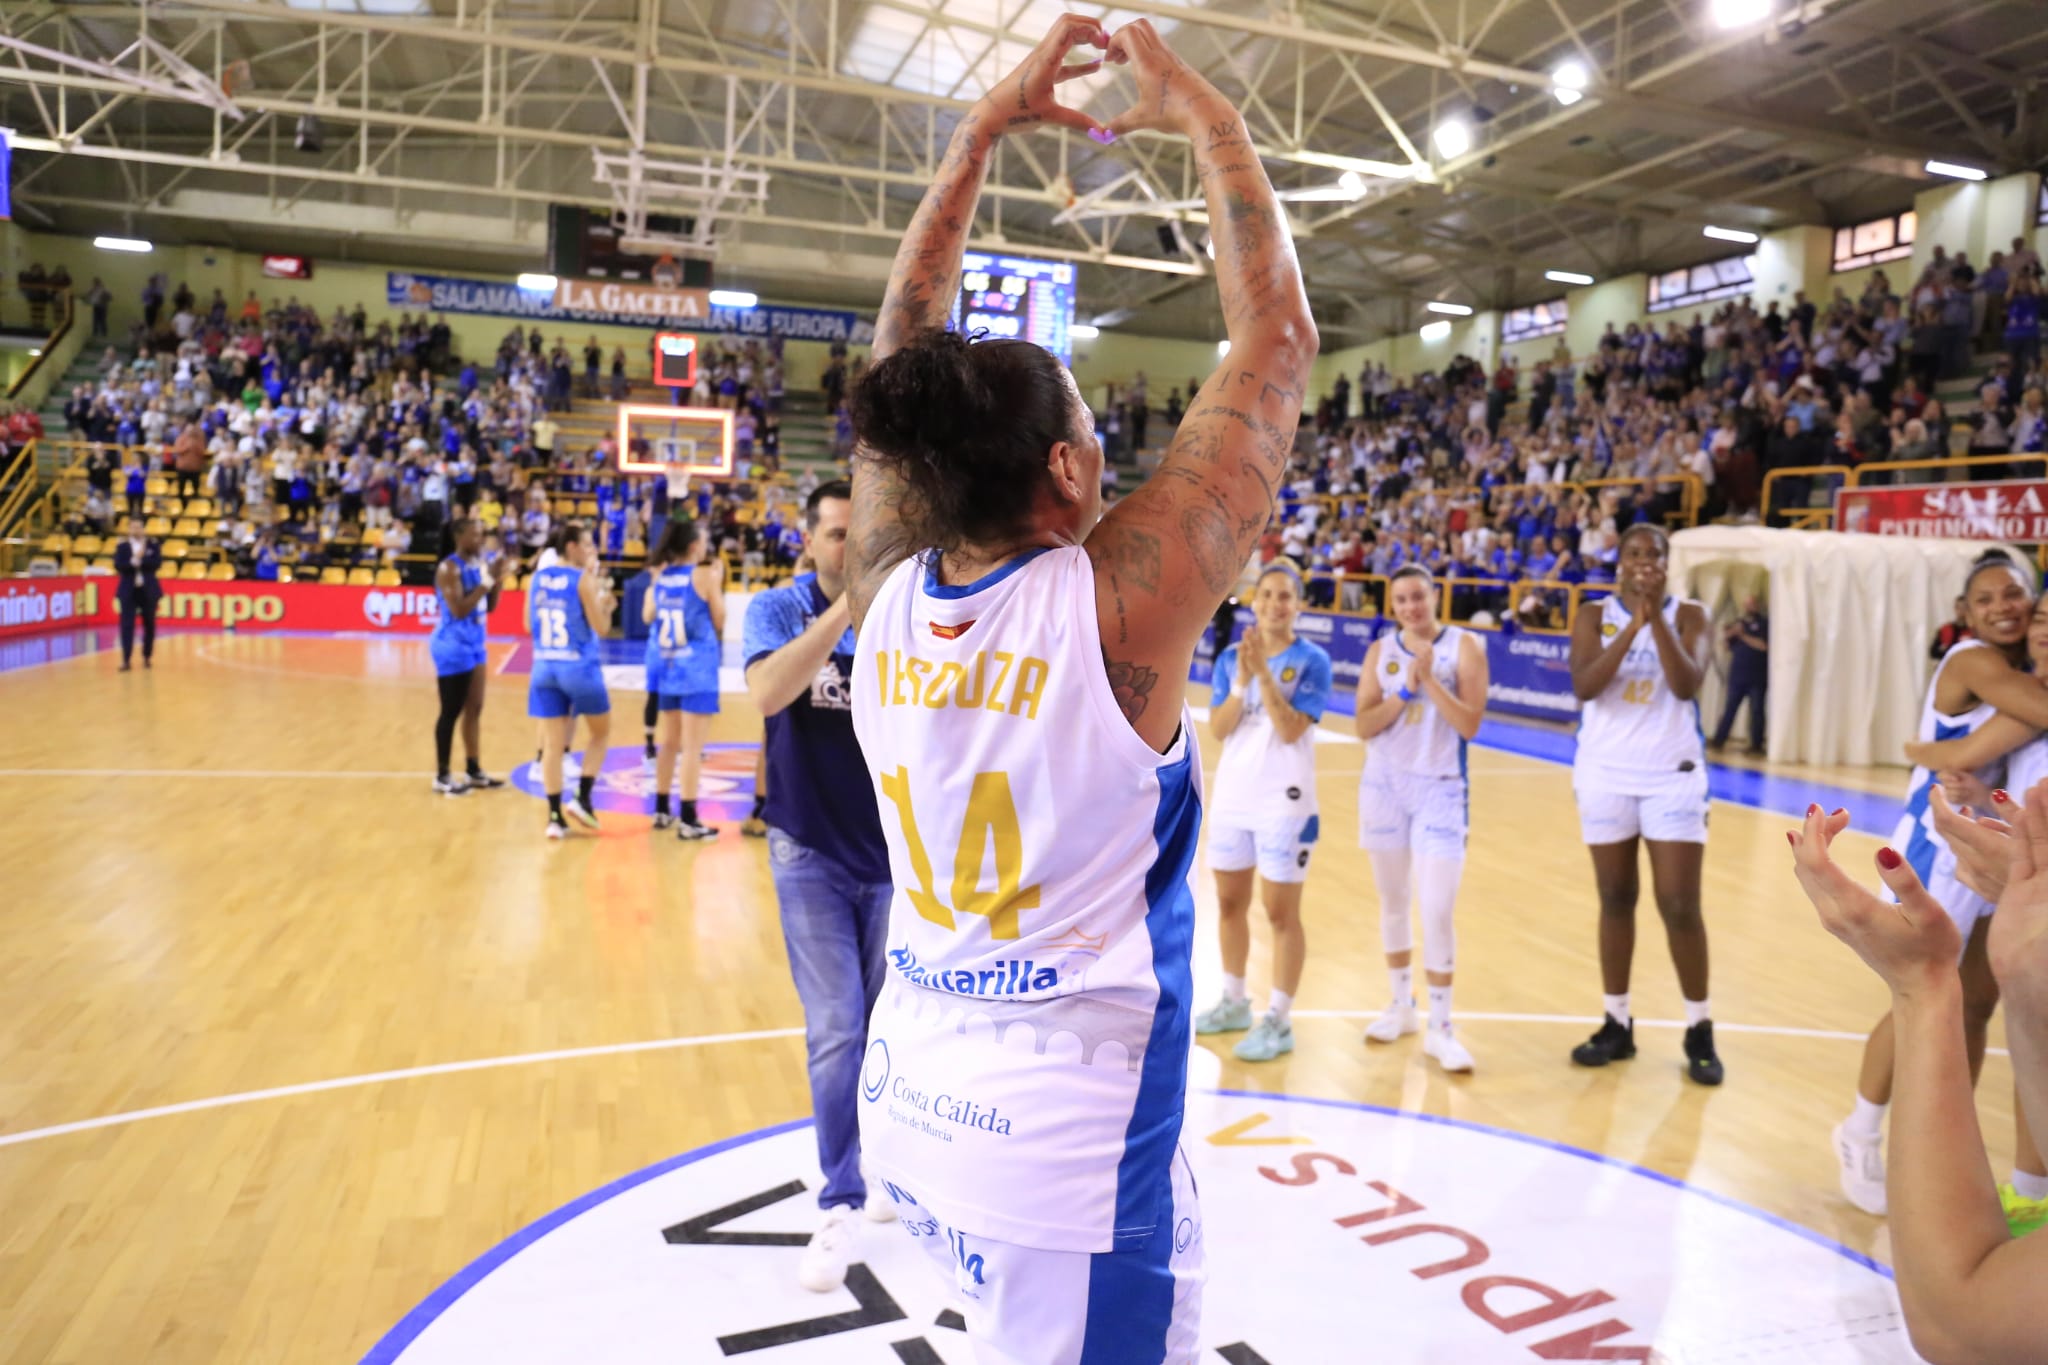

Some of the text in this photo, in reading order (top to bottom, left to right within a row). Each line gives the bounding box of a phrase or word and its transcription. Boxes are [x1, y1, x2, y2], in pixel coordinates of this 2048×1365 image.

[561, 280, 699, 317] LA GACETA
[537, 607, 569, 648] 13
[658, 608, 688, 648] 21
[880, 764, 1041, 940] 14
[893, 1076, 1012, 1136] Costa Cálida
